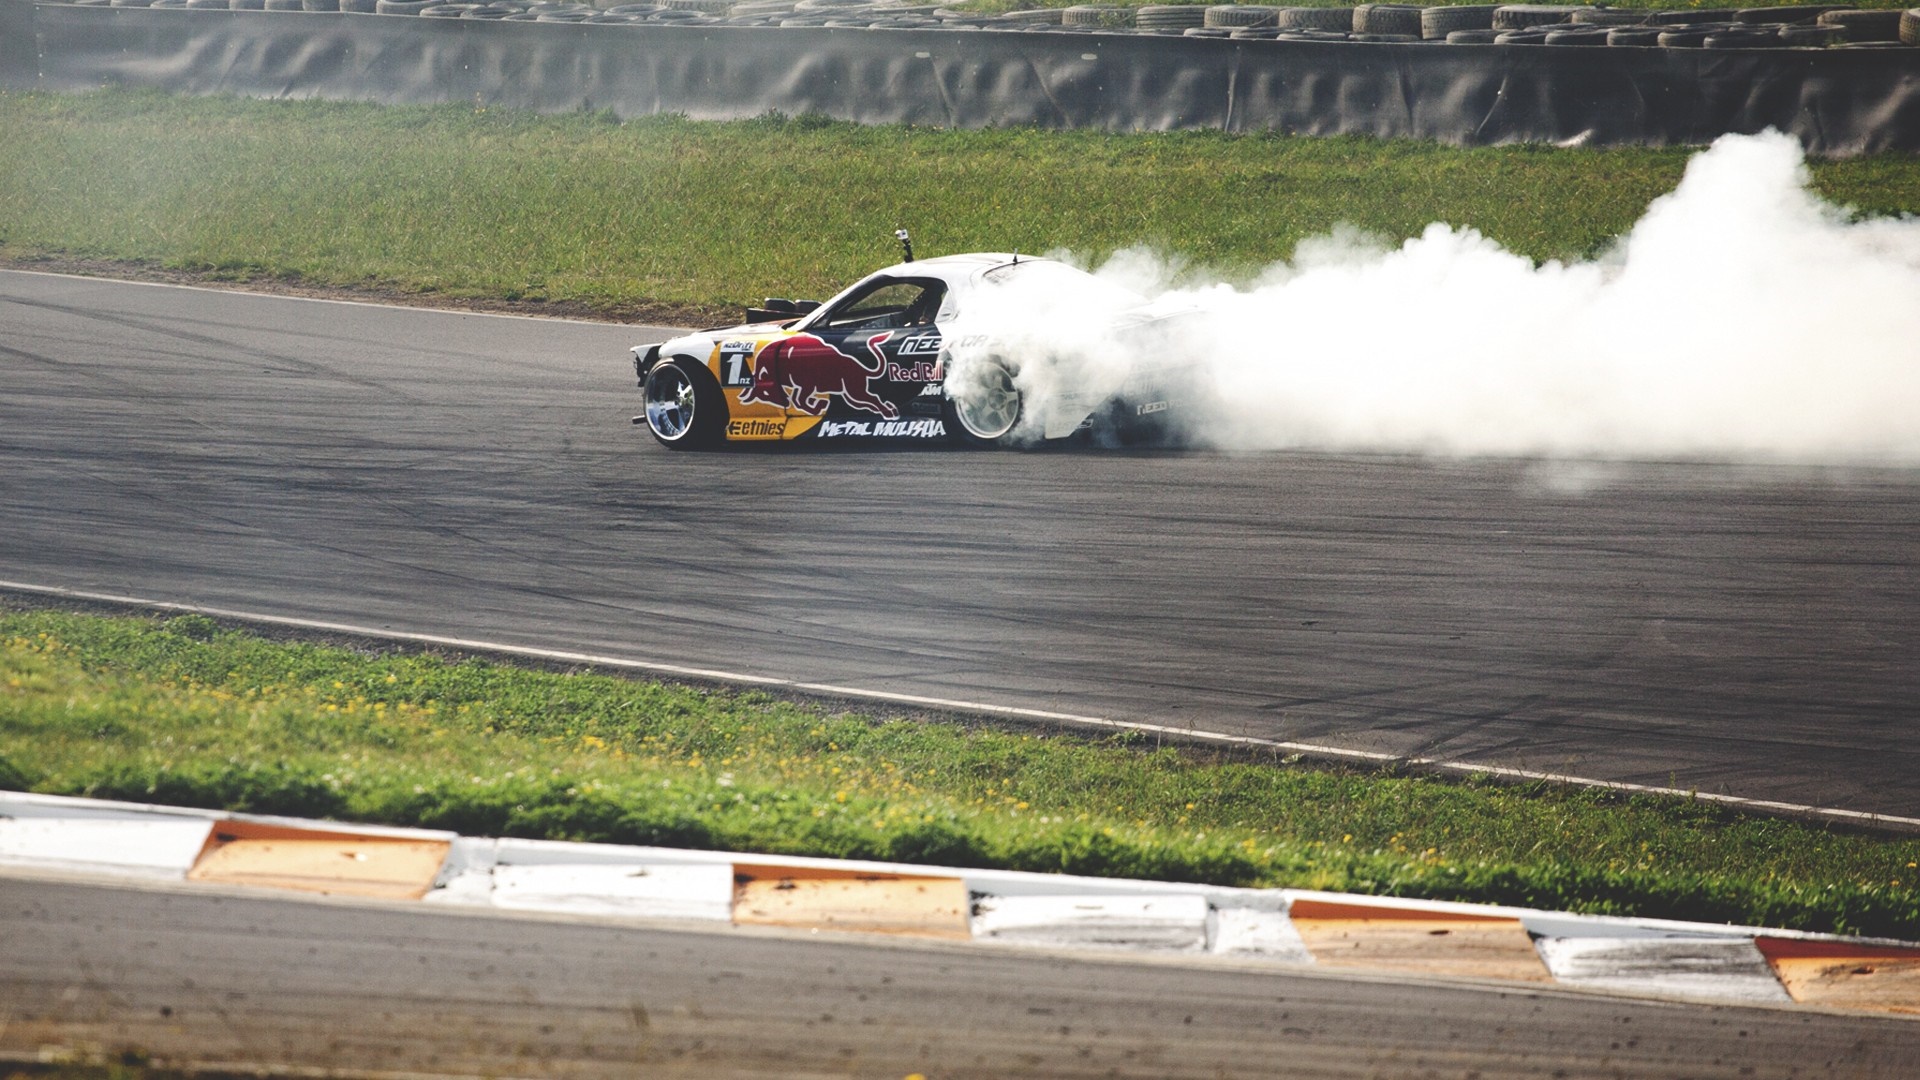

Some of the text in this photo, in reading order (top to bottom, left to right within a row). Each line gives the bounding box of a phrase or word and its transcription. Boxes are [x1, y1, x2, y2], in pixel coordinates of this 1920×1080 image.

[897, 336, 945, 355] NEE
[727, 354, 744, 385] 1
[888, 360, 944, 382] Red Bull
[918, 383, 942, 396] KTM
[741, 420, 785, 436] etnies
[818, 419, 946, 438] METAL MULISHA
